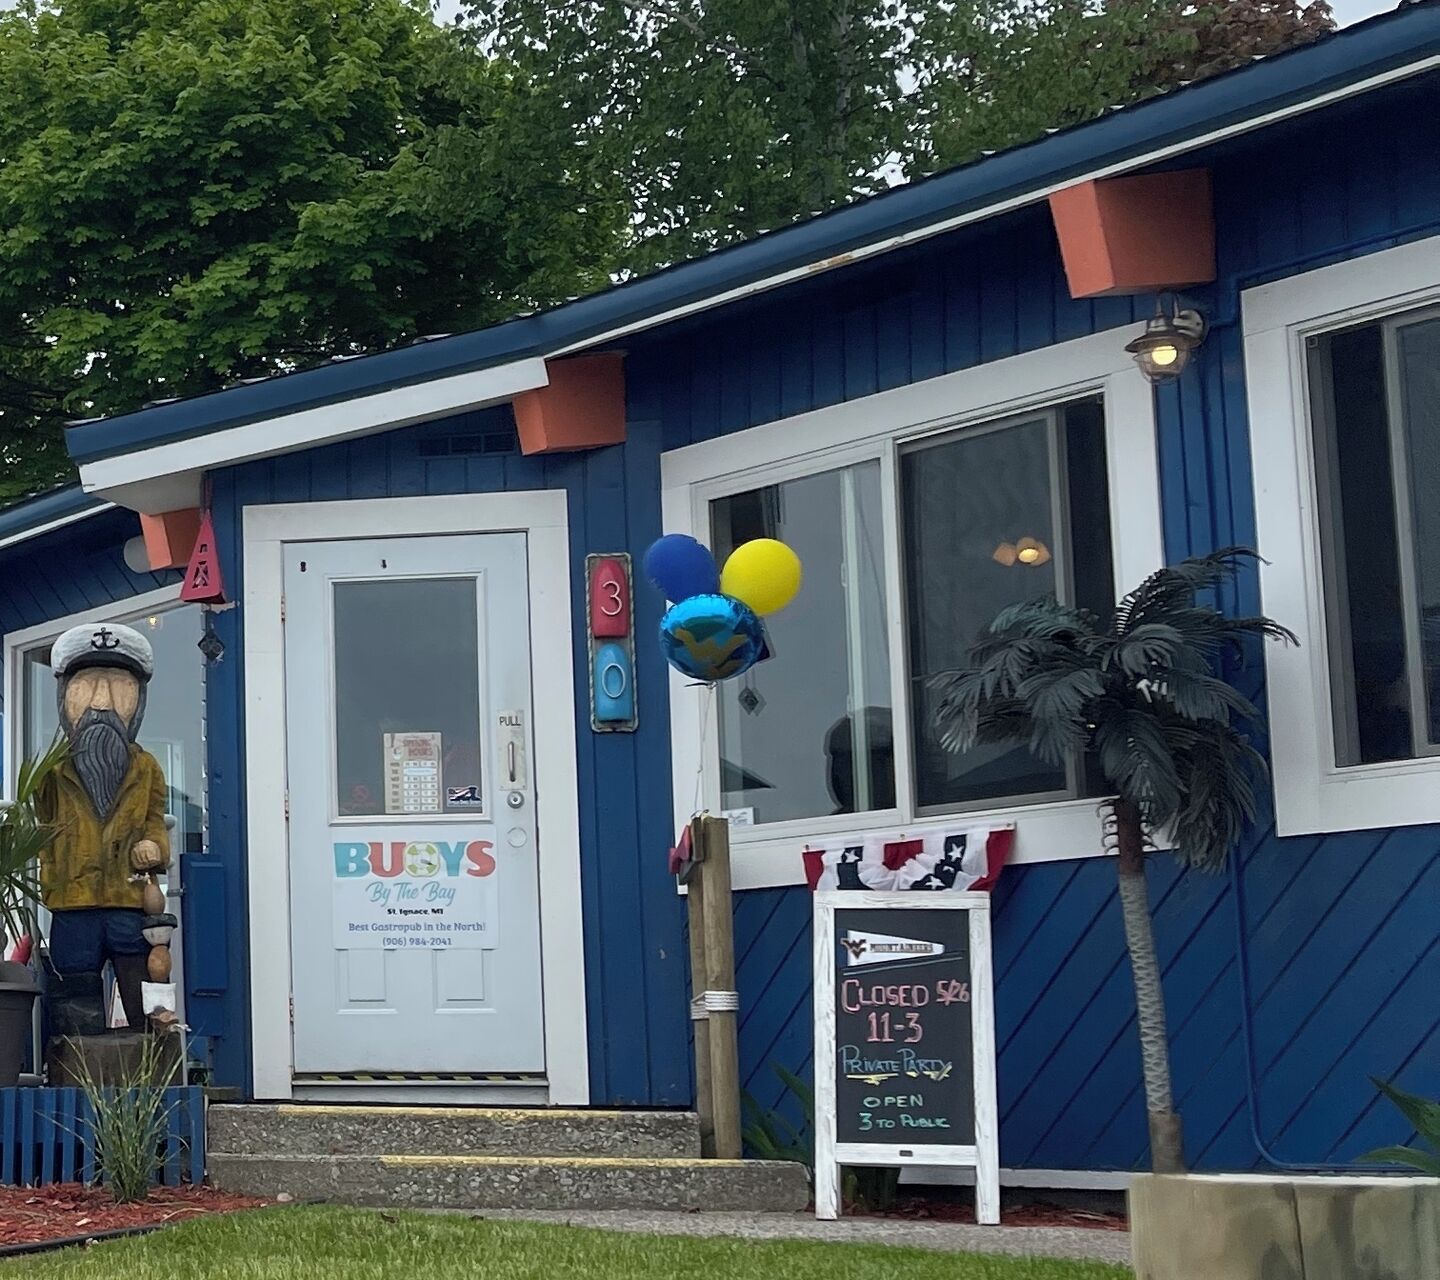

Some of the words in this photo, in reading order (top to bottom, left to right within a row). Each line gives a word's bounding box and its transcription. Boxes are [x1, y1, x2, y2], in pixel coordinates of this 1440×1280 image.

[600, 581, 623, 616] 3
[499, 716, 522, 726] PULL
[334, 840, 496, 877] BUOYS
[365, 881, 391, 907] By
[392, 881, 419, 902] The
[421, 881, 456, 907] Bay
[349, 923, 369, 931] Best
[371, 923, 422, 933] Gastropub
[424, 923, 434, 931] in
[435, 923, 451, 931] the
[454, 923, 486, 931] North!
[382, 937, 407, 946] (906)
[409, 937, 452, 946] 984-2041
[841, 979, 930, 1014] CLOSED
[867, 1011, 924, 1043] 11-3
[863, 1094, 924, 1108] OPEN
[858, 1113, 873, 1131] 3
[876, 1119, 896, 1128] TO
[899, 1114, 951, 1128] PUBLIC
